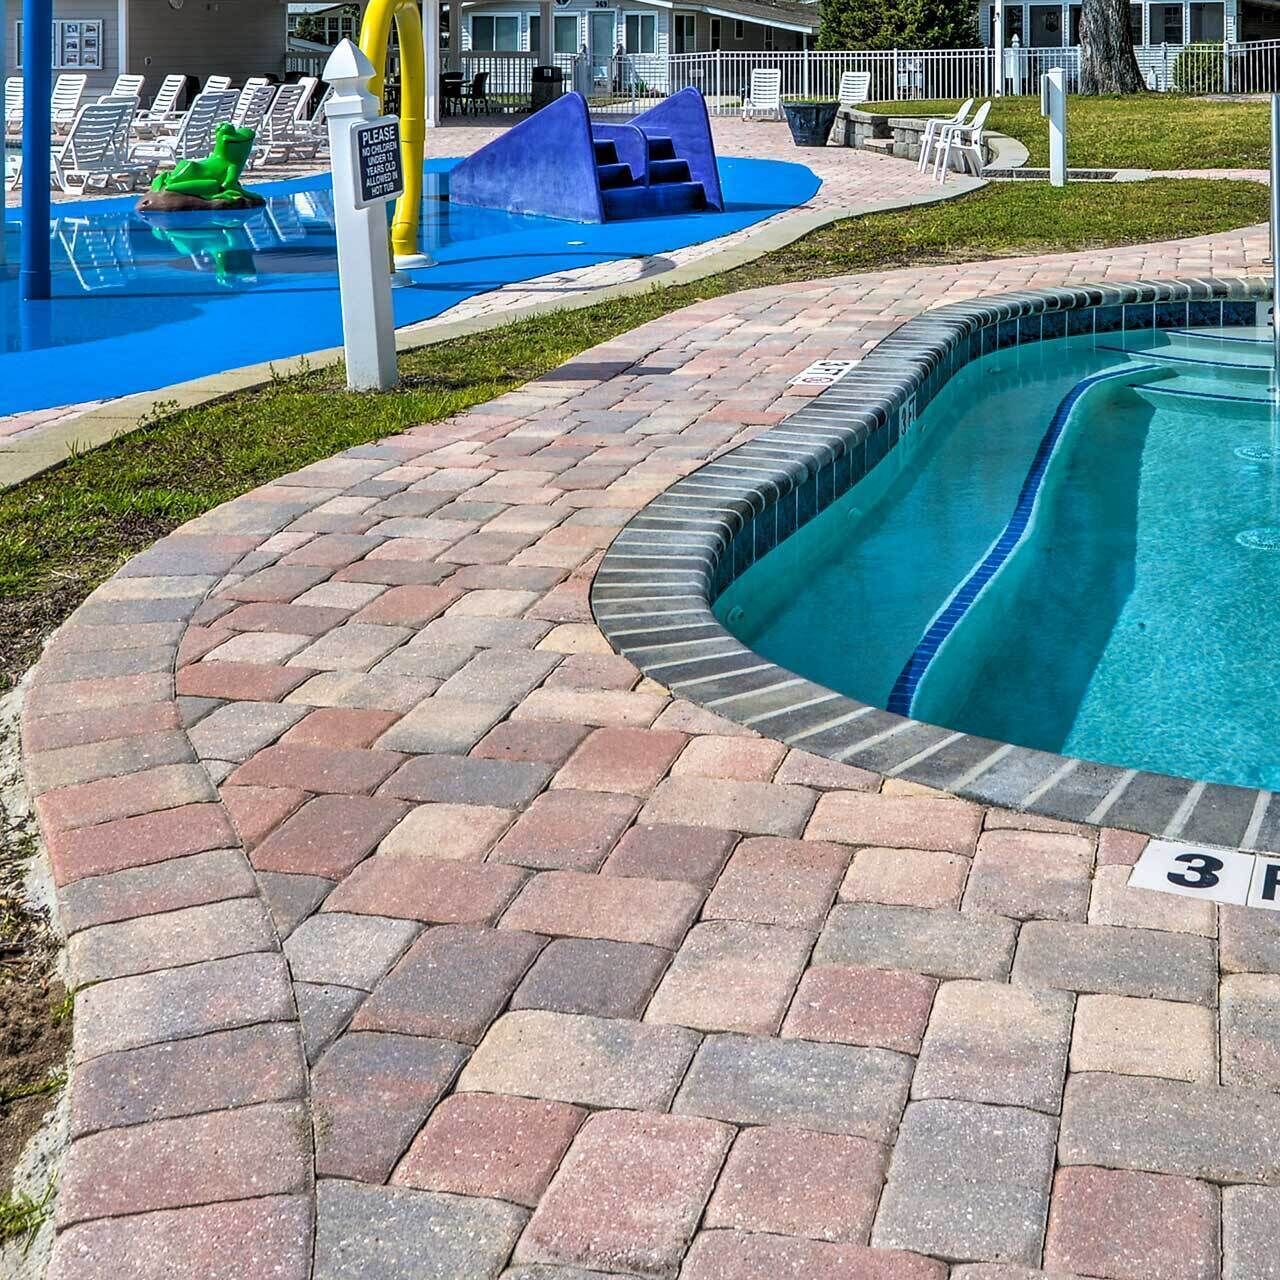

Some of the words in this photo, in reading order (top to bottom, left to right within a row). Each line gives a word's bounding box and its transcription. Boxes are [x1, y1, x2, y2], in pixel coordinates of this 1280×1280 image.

[362, 126, 395, 146] PLEASE
[362, 147, 370, 157] NO
[371, 141, 397, 155] CHILDREN
[367, 153, 386, 166] UNDER
[387, 152, 393, 161] 12
[366, 164, 384, 176] YEARS
[385, 161, 396, 172] OLD
[366, 172, 391, 188] ALLOWED
[392, 170, 398, 180] IN
[371, 184, 383, 196] HOT
[383, 181, 394, 192] TUB
[1167, 852, 1224, 889] 3
